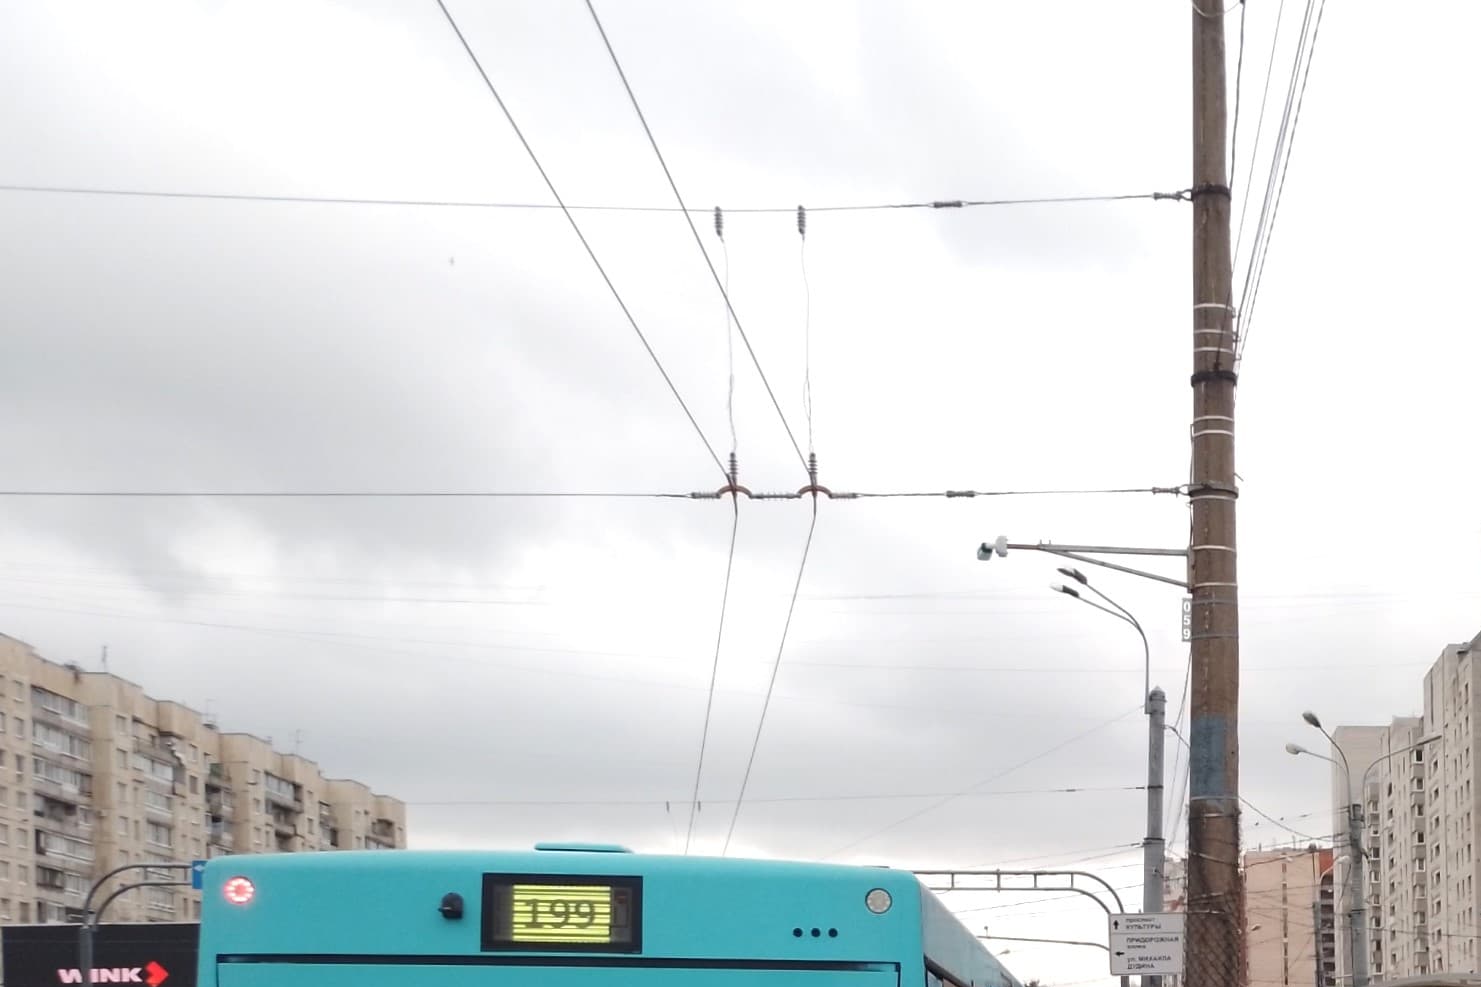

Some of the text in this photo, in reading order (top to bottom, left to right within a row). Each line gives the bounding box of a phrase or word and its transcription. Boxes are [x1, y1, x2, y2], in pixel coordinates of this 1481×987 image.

[1183, 601, 1191, 640] 059
[524, 898, 596, 929] 199
[57, 967, 143, 984] WINK
